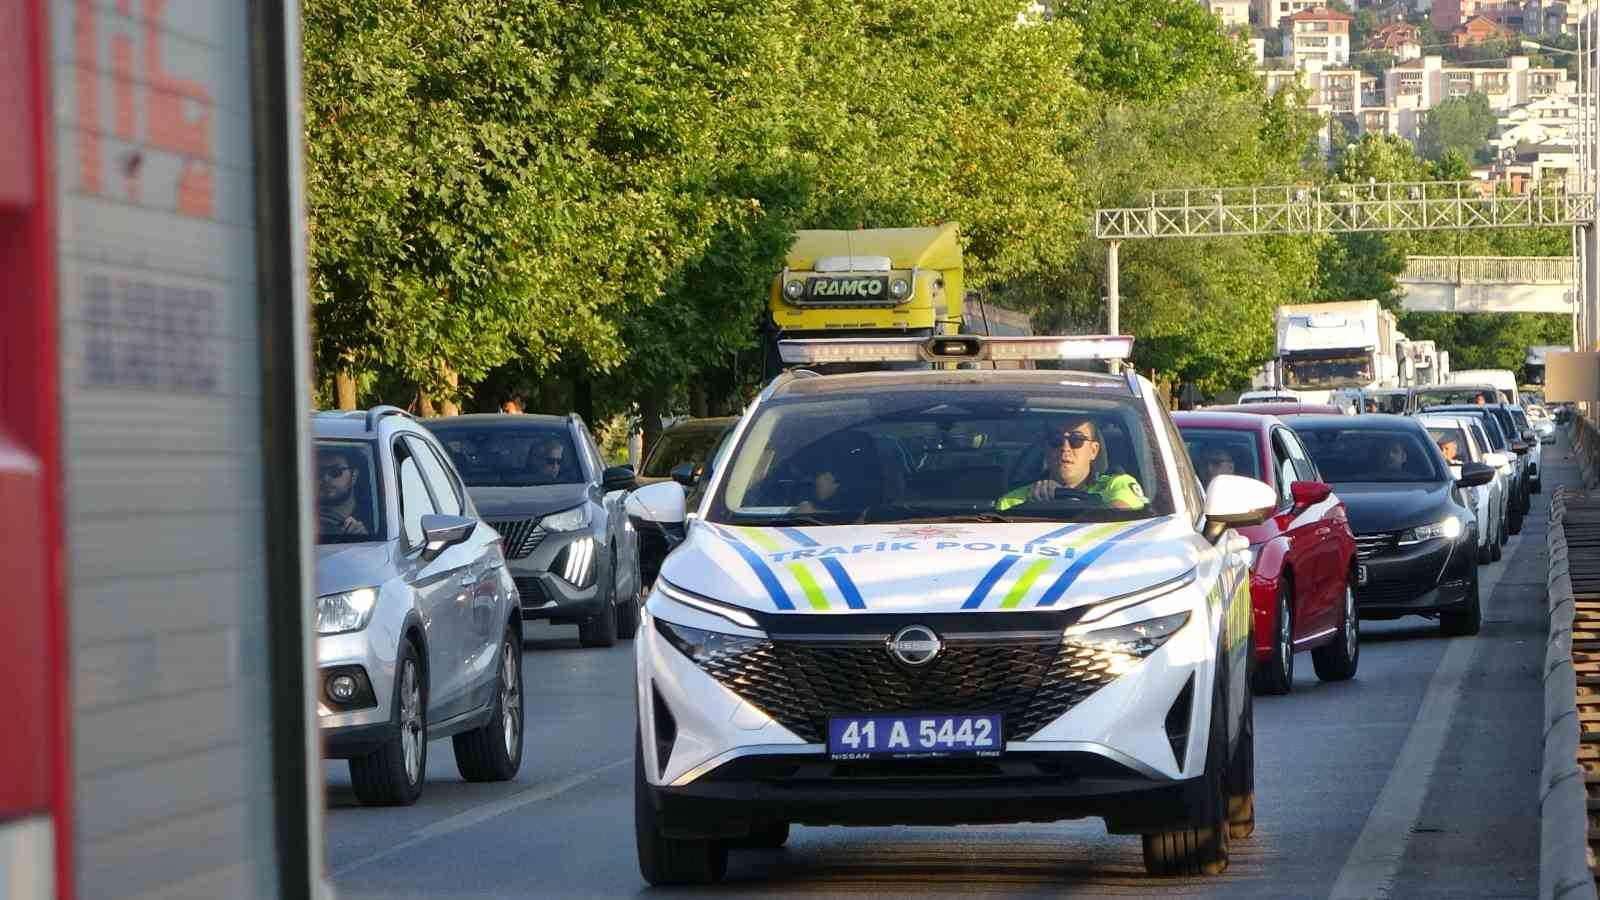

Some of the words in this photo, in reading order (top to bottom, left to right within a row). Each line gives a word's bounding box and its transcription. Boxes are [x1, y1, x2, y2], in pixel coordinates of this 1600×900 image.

[841, 720, 876, 749] 41
[887, 720, 911, 748] A
[919, 718, 993, 748] 5442
